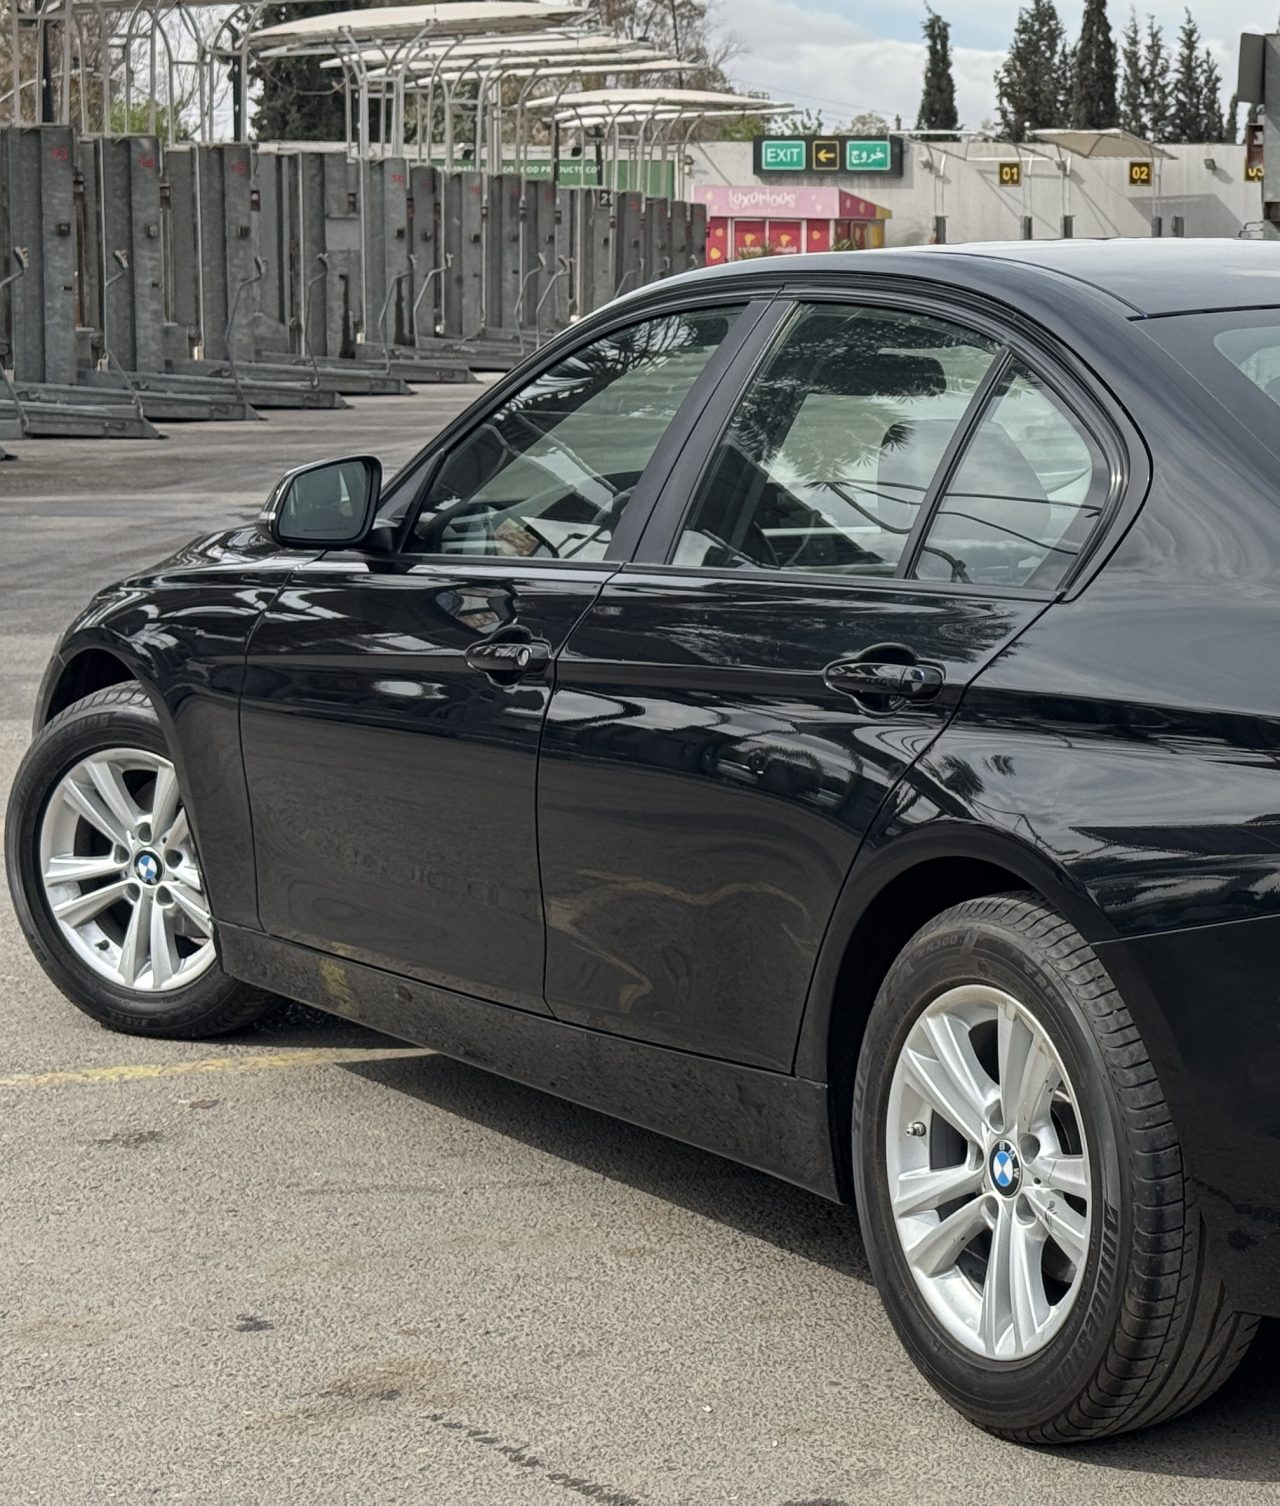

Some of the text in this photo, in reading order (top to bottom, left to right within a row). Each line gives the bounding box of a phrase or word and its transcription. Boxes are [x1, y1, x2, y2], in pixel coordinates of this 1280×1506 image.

[766, 148, 801, 163] EXIT
[850, 147, 885, 164] خروج
[1002, 166, 1018, 181] 01
[1132, 166, 1149, 180] 02
